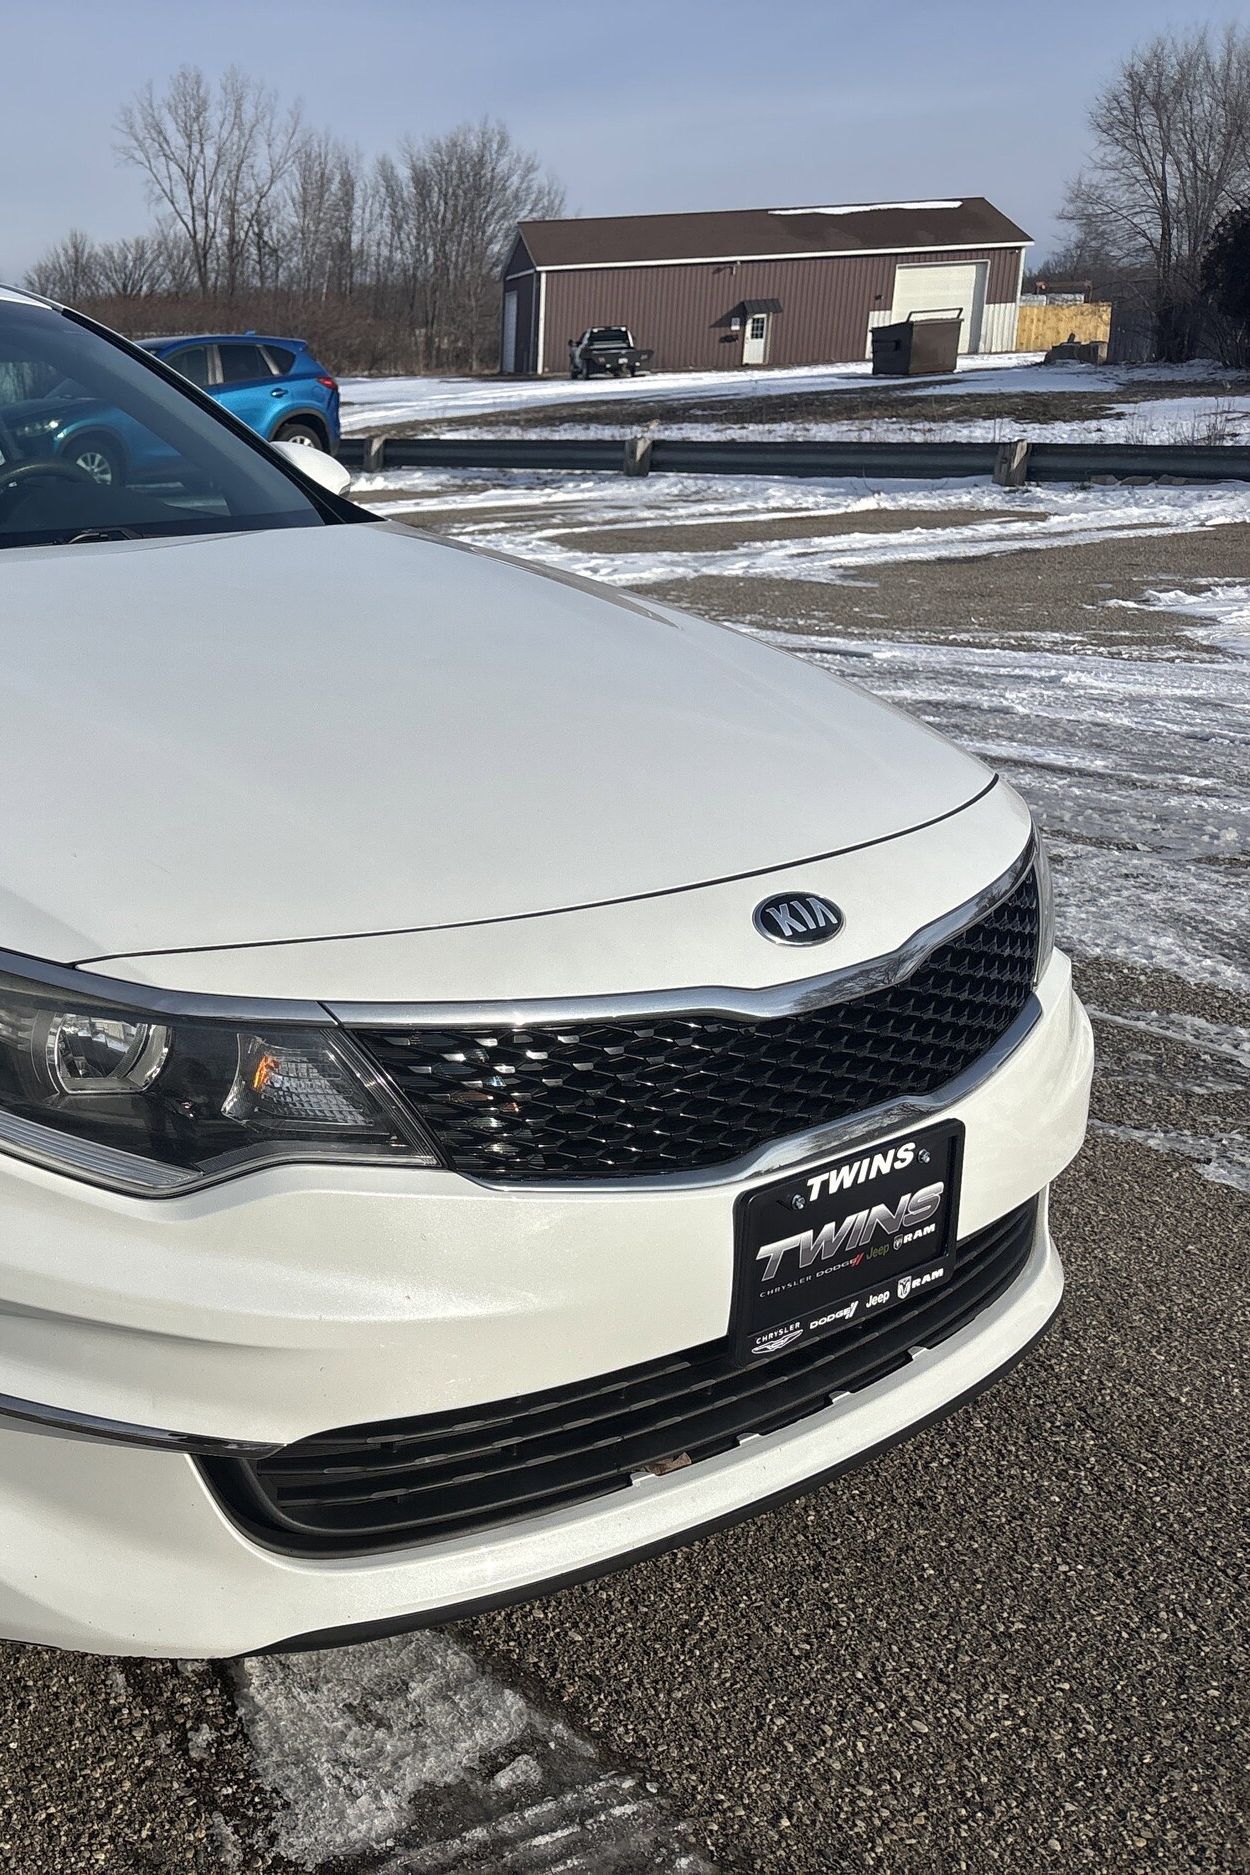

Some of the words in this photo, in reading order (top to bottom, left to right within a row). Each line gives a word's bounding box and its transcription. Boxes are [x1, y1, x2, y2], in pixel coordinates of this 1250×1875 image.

[765, 897, 839, 937] KIA
[806, 1142, 916, 1202] TWINS
[755, 1181, 945, 1282] TWINS
[759, 1274, 812, 1298] CHRYSLER
[816, 1257, 857, 1278] DODGE
[865, 1242, 890, 1261] Jeep
[903, 1223, 936, 1244] RAM
[755, 1321, 801, 1345] CHRYSLER
[809, 1307, 851, 1330] DODGE
[865, 1290, 890, 1309] Jeep
[911, 1267, 944, 1289] RAM
